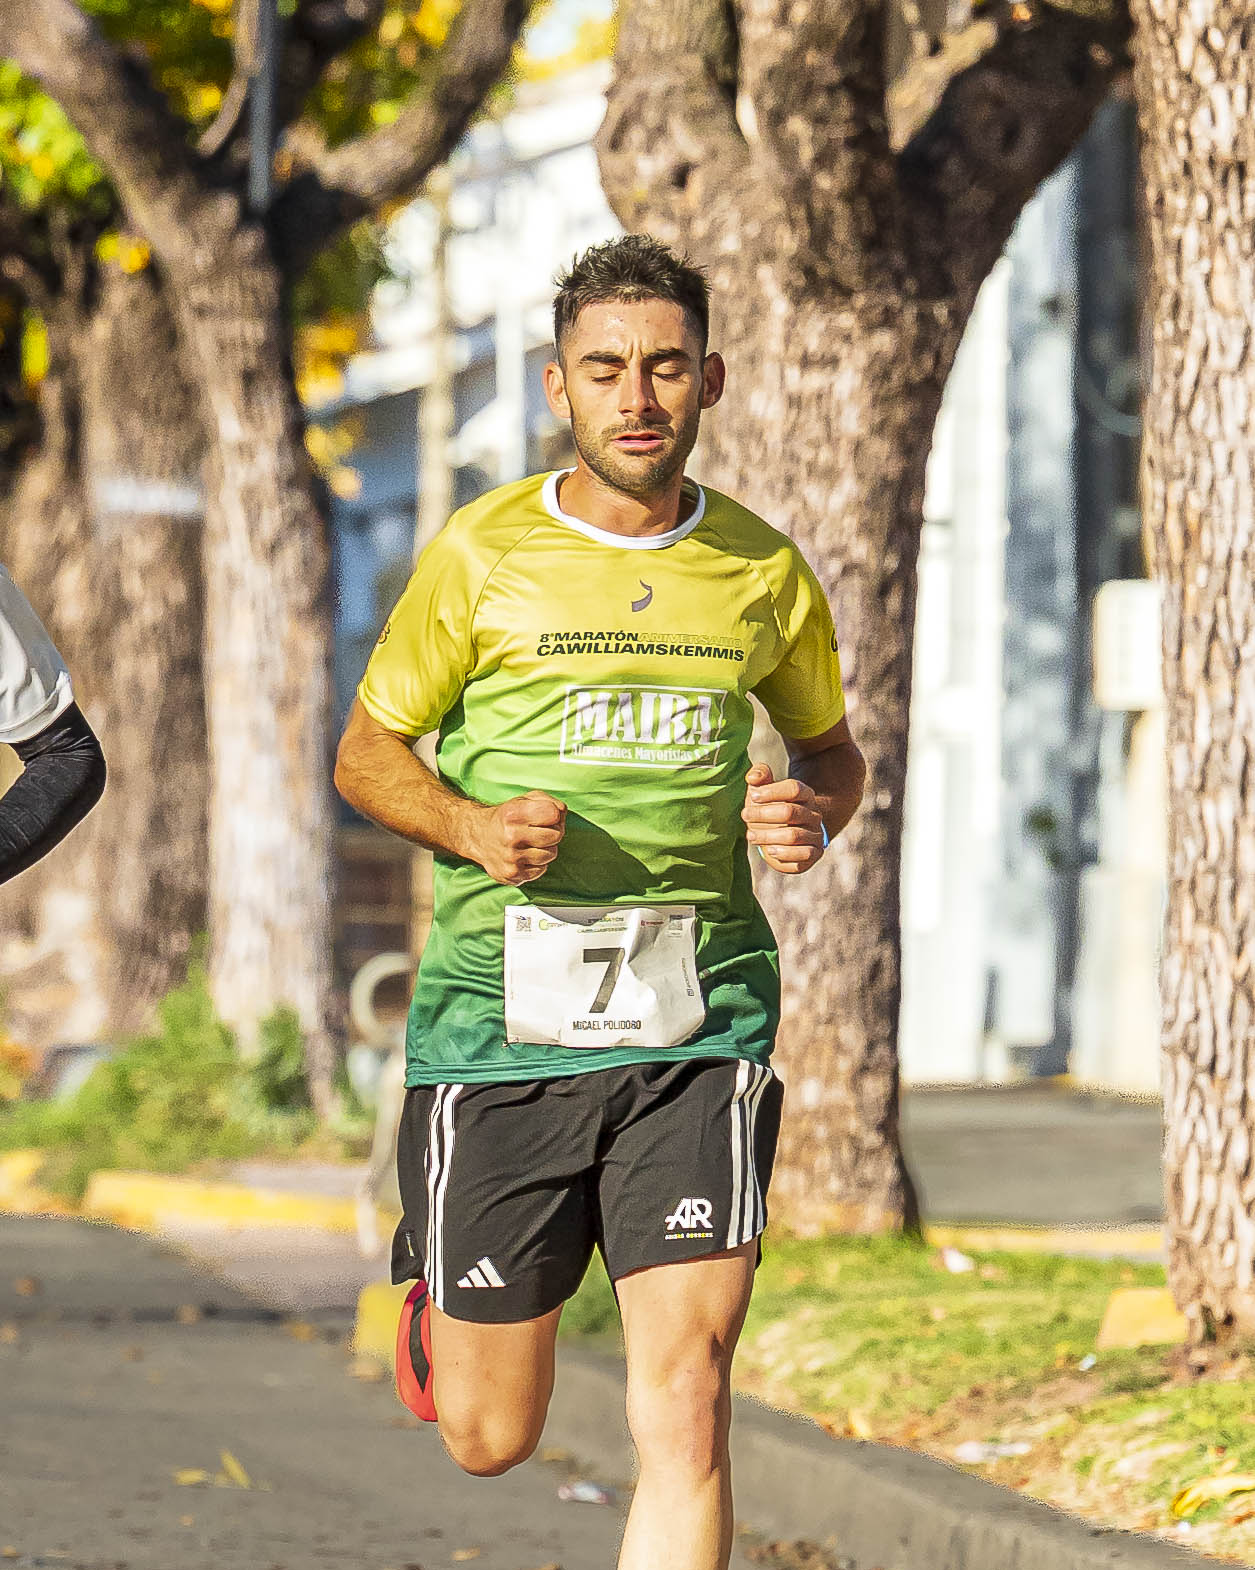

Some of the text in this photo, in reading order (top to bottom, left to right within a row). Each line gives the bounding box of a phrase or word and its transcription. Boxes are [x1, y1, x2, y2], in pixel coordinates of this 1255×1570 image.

[536, 642, 745, 662] CAWILLIAMSKEMMIS
[572, 691, 712, 746] MAIRA
[583, 947, 625, 1014] 7
[664, 1197, 714, 1230] AR
